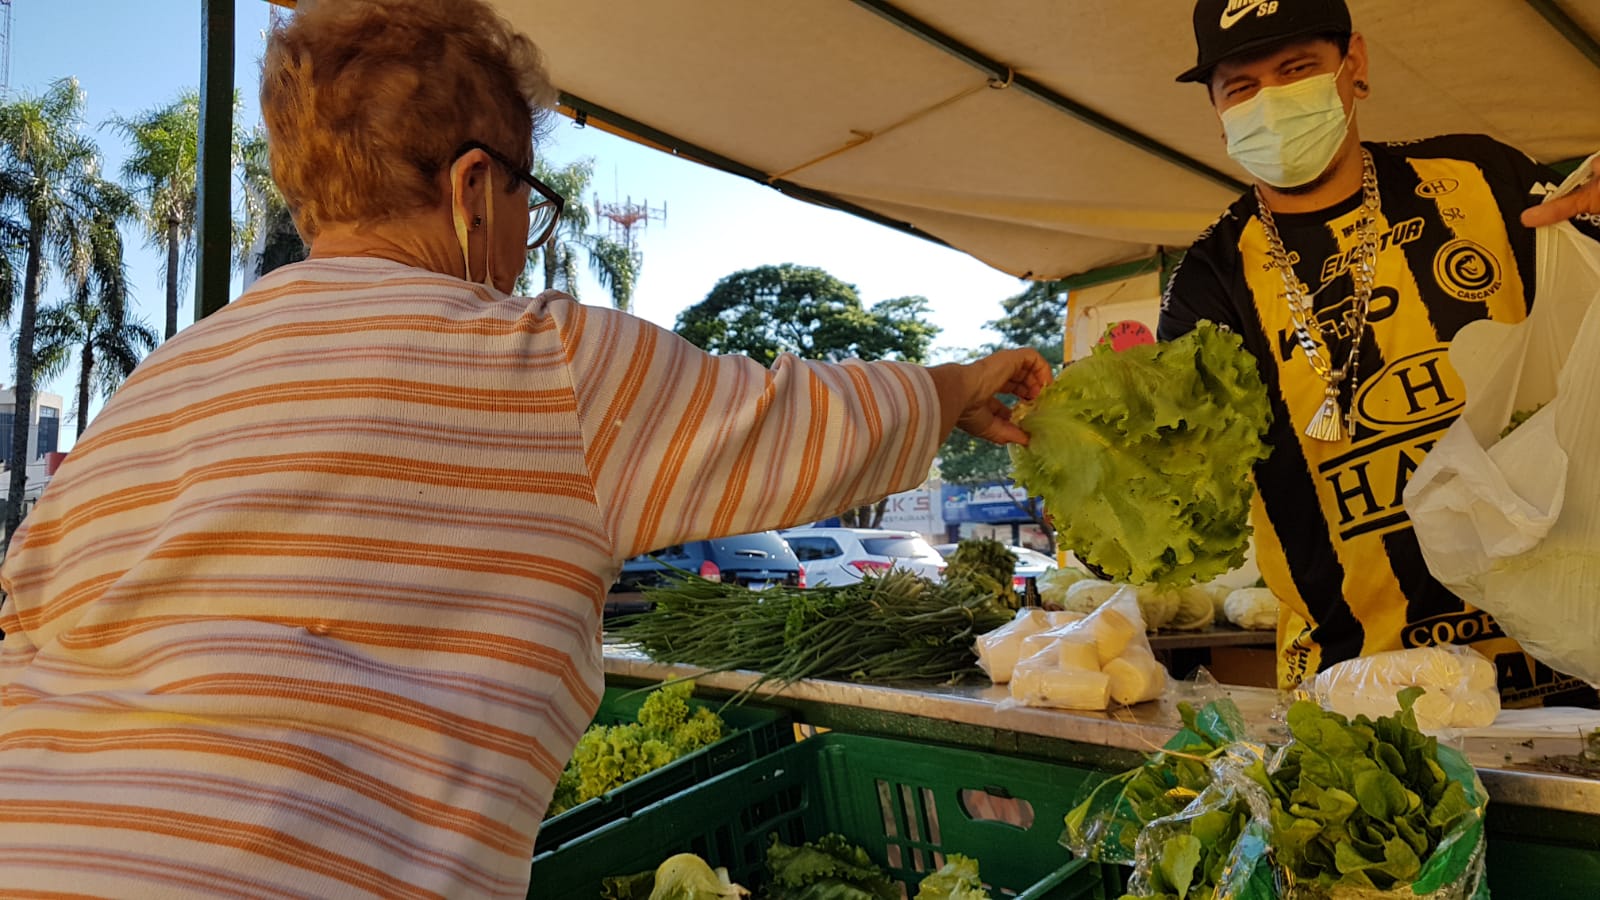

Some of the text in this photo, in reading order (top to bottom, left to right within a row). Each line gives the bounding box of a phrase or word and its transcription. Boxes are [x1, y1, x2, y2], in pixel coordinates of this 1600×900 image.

[1256, 1, 1279, 17] SB
[1441, 207, 1466, 221] SR
[1456, 281, 1502, 300] CASCAVEL
[1392, 356, 1455, 417] H
